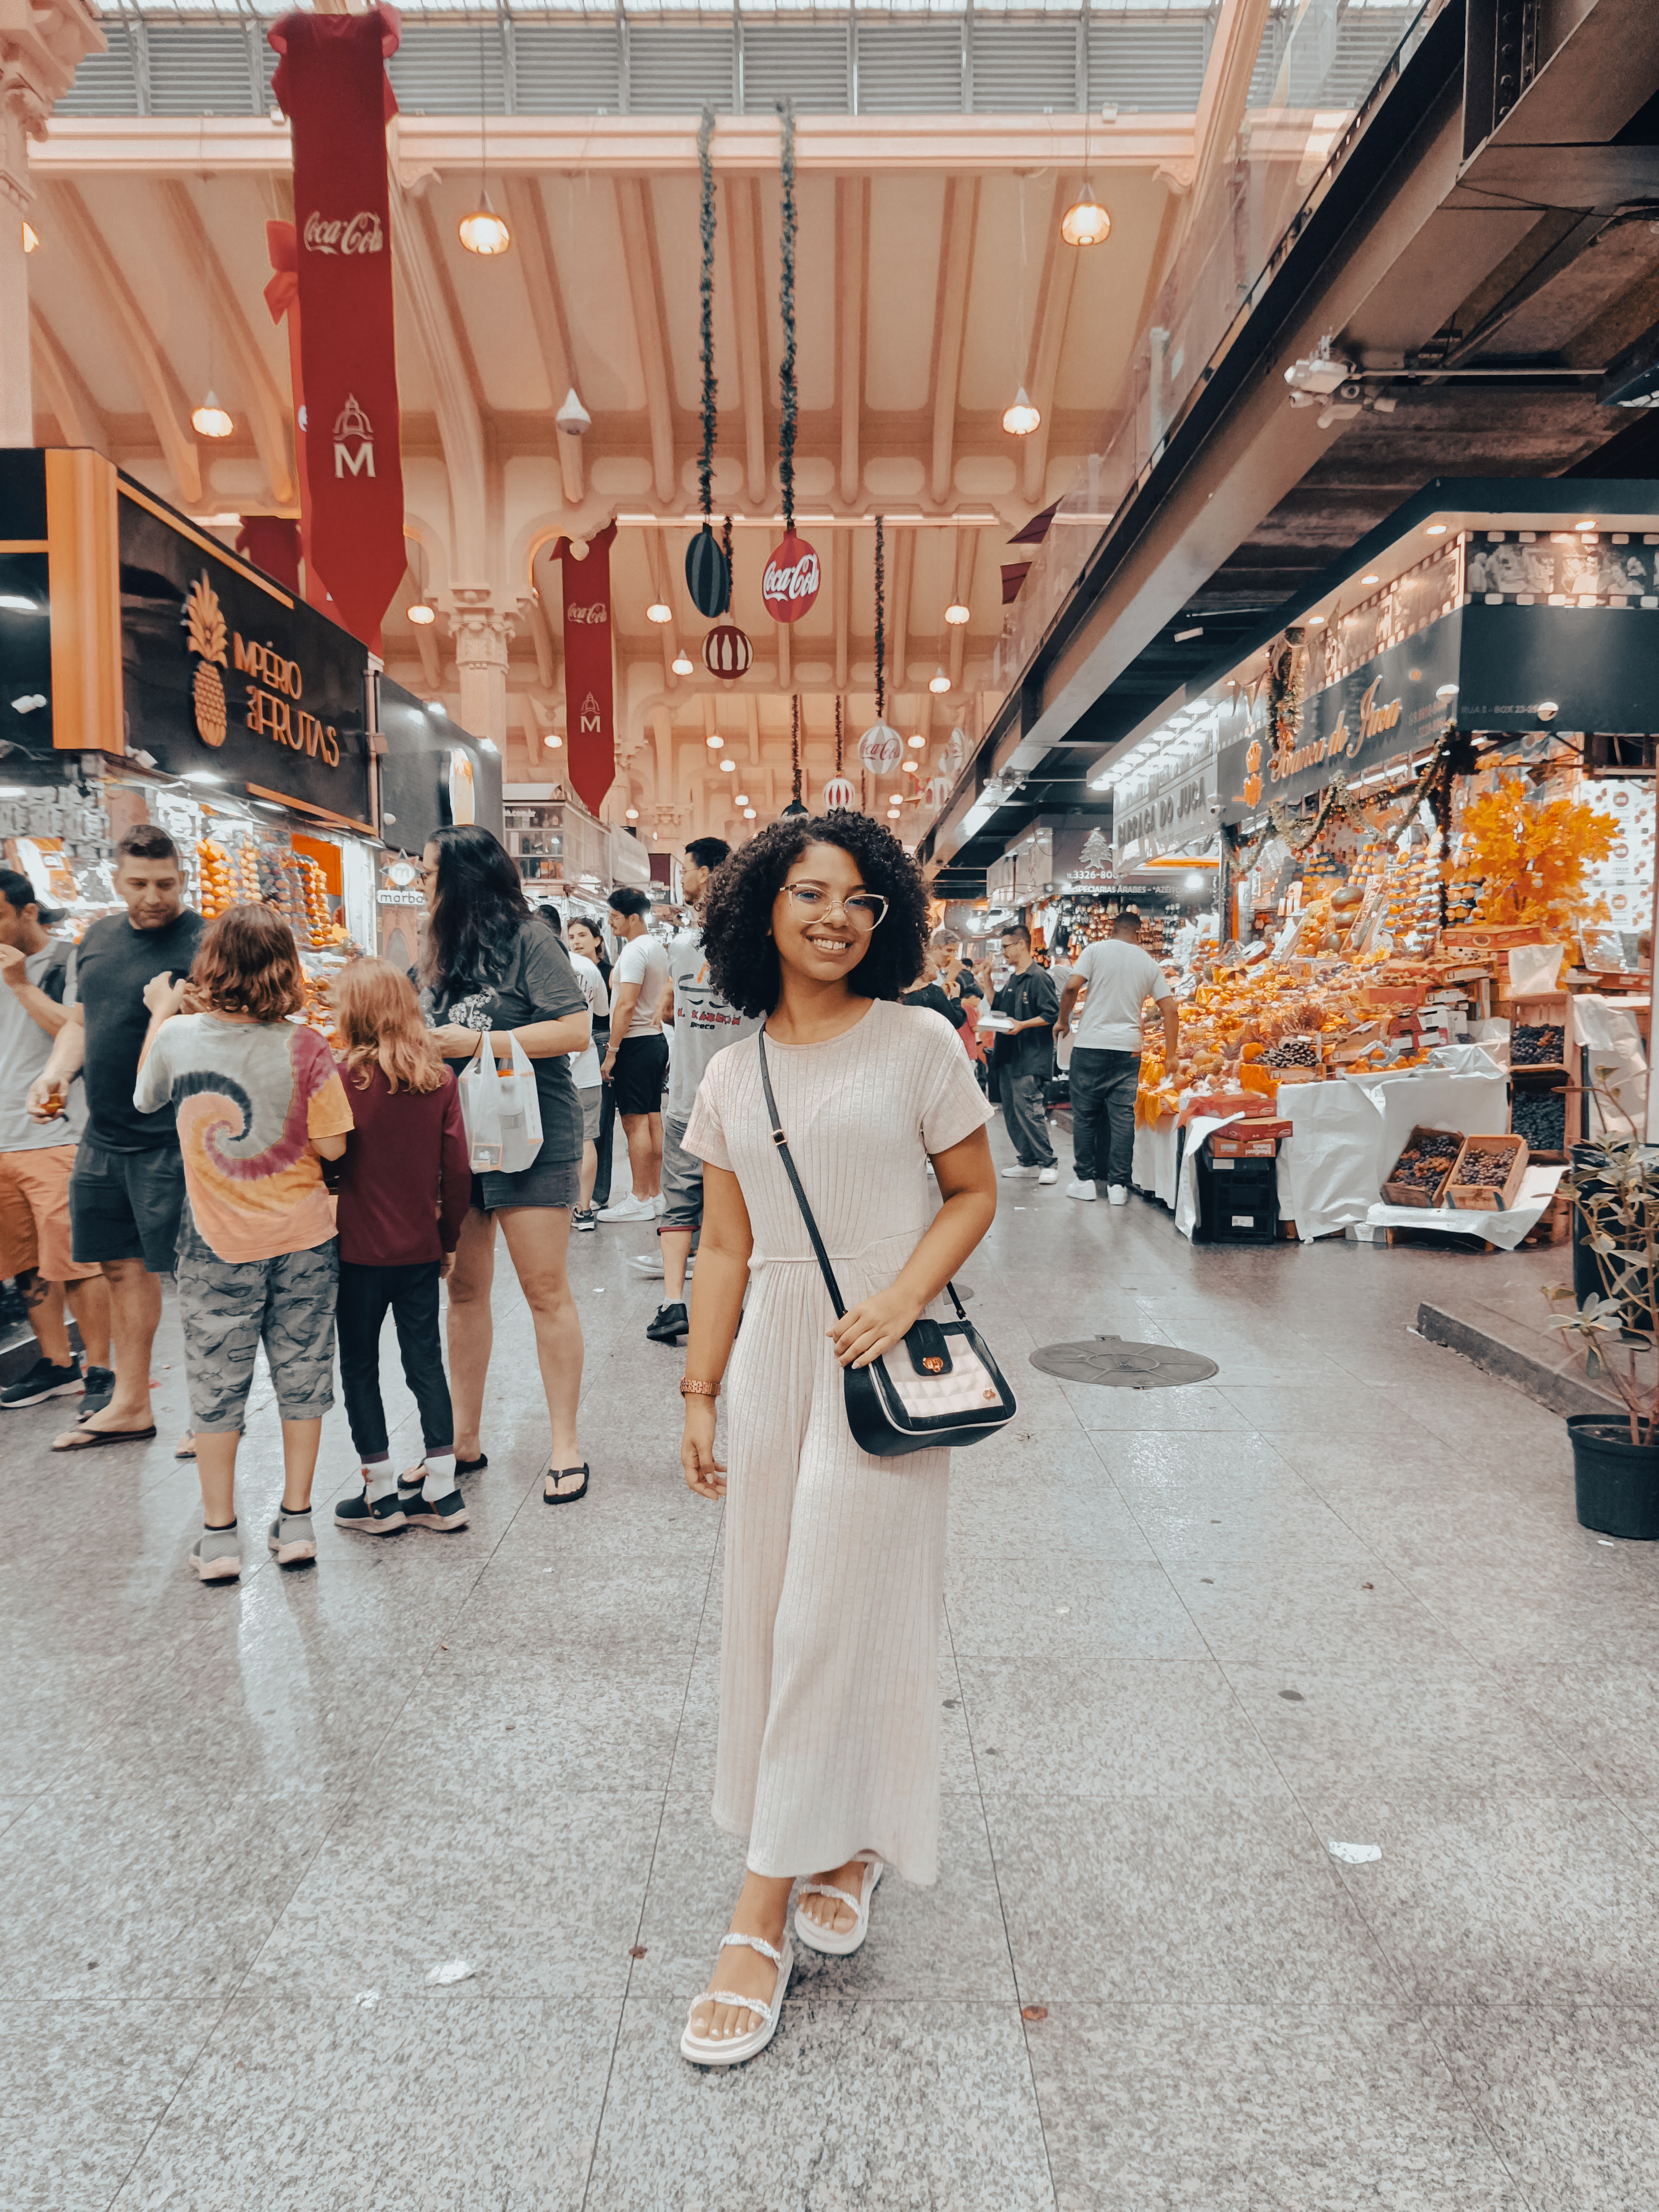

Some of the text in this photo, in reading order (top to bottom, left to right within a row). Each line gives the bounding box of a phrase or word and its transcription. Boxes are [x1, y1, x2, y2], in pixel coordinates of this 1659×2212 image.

[304, 211, 383, 257] Coca-Cola
[333, 442, 376, 478] M
[763, 552, 819, 602] Coca-Cola
[254, 689, 340, 767] FRUTAS
[1117, 805, 1157, 849] BARRACA
[1159, 795, 1174, 828] DO
[1177, 777, 1206, 818] JUCA
